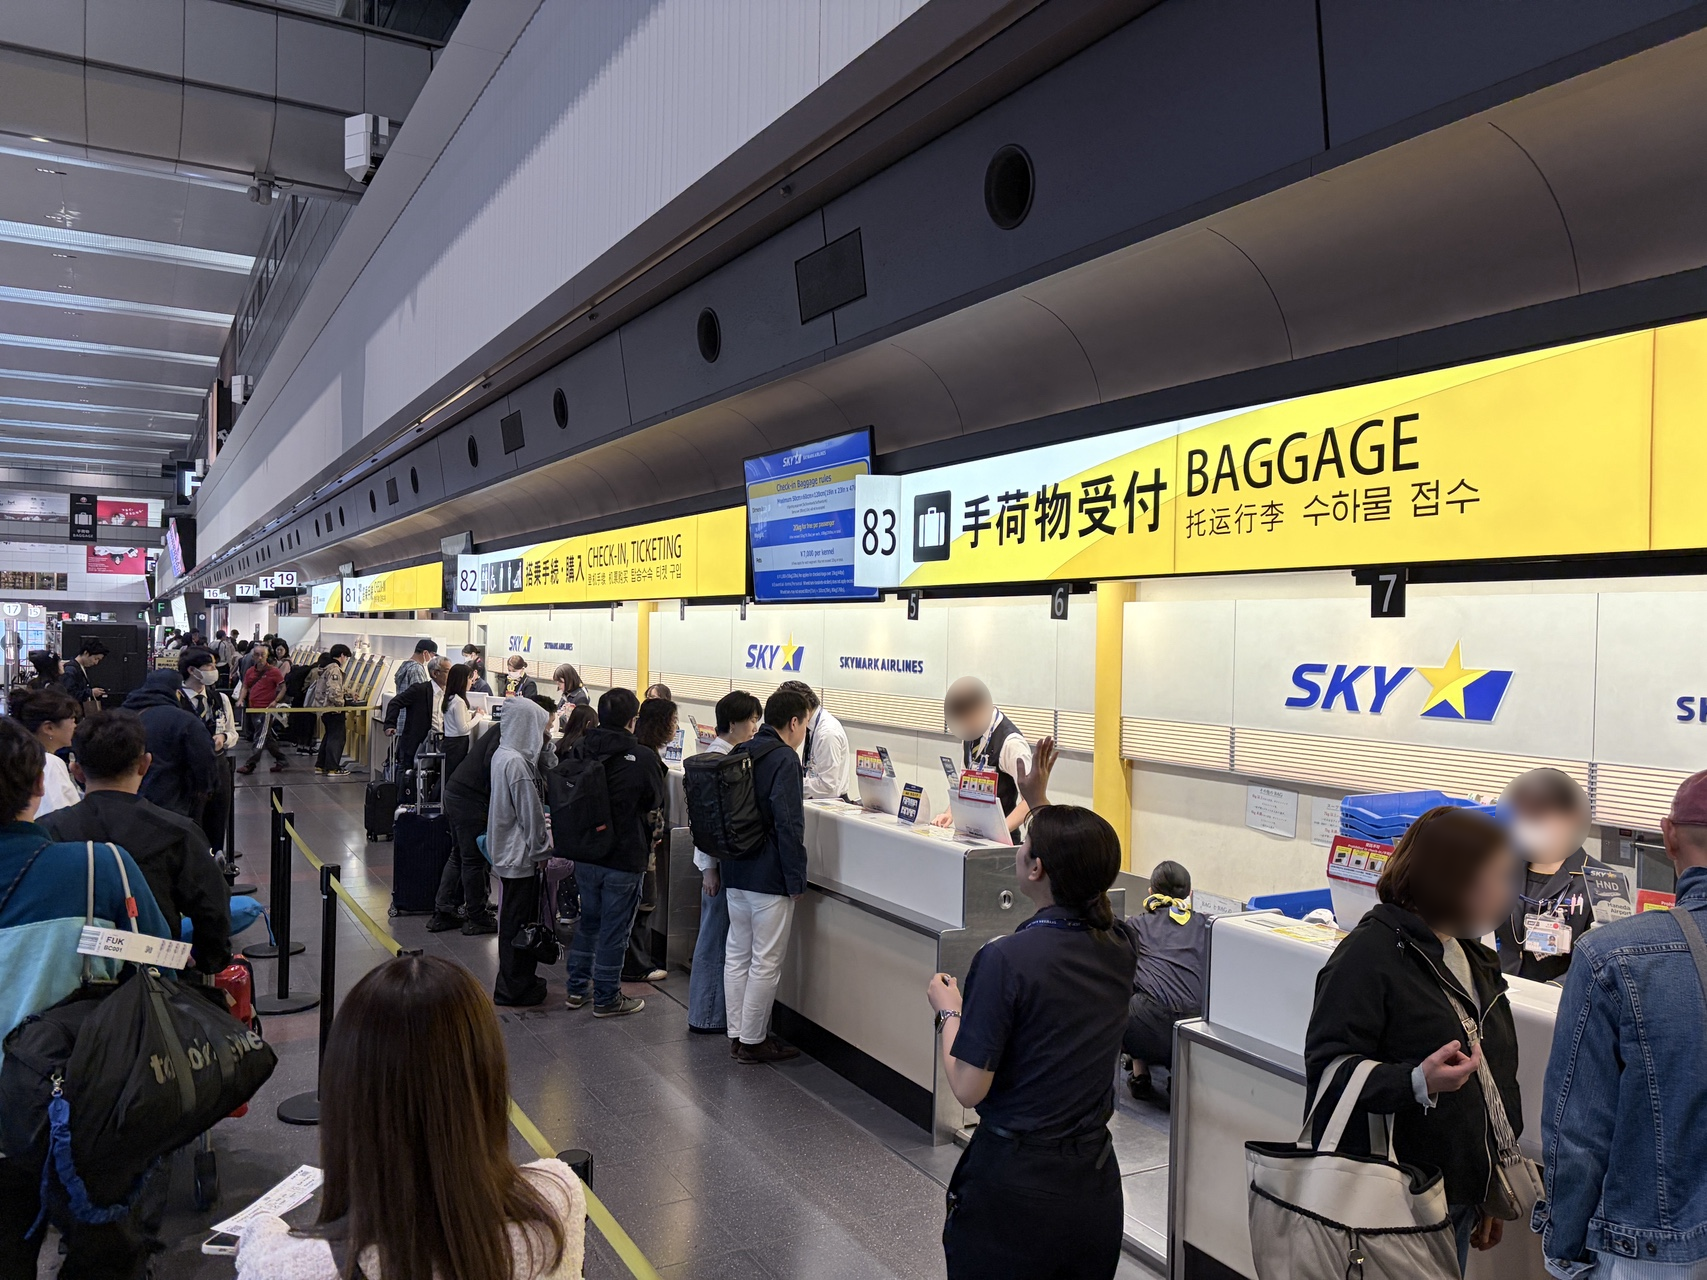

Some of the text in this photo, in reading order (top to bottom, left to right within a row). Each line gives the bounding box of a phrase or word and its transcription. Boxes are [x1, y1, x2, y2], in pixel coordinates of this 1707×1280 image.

[1186, 412, 1420, 497] BAGGAGE
[776, 474, 832, 492] Check-in Baggage rules
[962, 467, 1167, 549] 手荷物受付
[1185, 478, 1481, 539] 托运行李 수하물 접수
[862, 508, 897, 556] 83
[587, 533, 682, 568] CHECK-IN, TICKETING
[670, 562, 682, 579] 구입
[277, 573, 294, 586] 19
[460, 569, 477, 592] 82
[207, 589, 219, 598] 16
[238, 585, 251, 595] 17
[345, 587, 356, 603] 81
[1378, 574, 1398, 613] 7
[6, 605, 18, 614] 17
[157, 602, 166, 613] F
[909, 593, 917, 618] 5
[1054, 587, 1065, 616] 6
[28, 608, 39, 616] 15
[508, 635, 524, 652] SKY
[745, 644, 780, 670] SKY
[839, 656, 924, 674] SKYMARK AIRLINES
[1284, 663, 1416, 714] SKY
[1590, 870, 1607, 878] SKY
[1595, 879, 1620, 891] HND
[1606, 902, 1632, 911] Haneda
[1610, 908, 1632, 917] Airport
[103, 945, 123, 953] BC001
[105, 936, 125, 946] FUK
